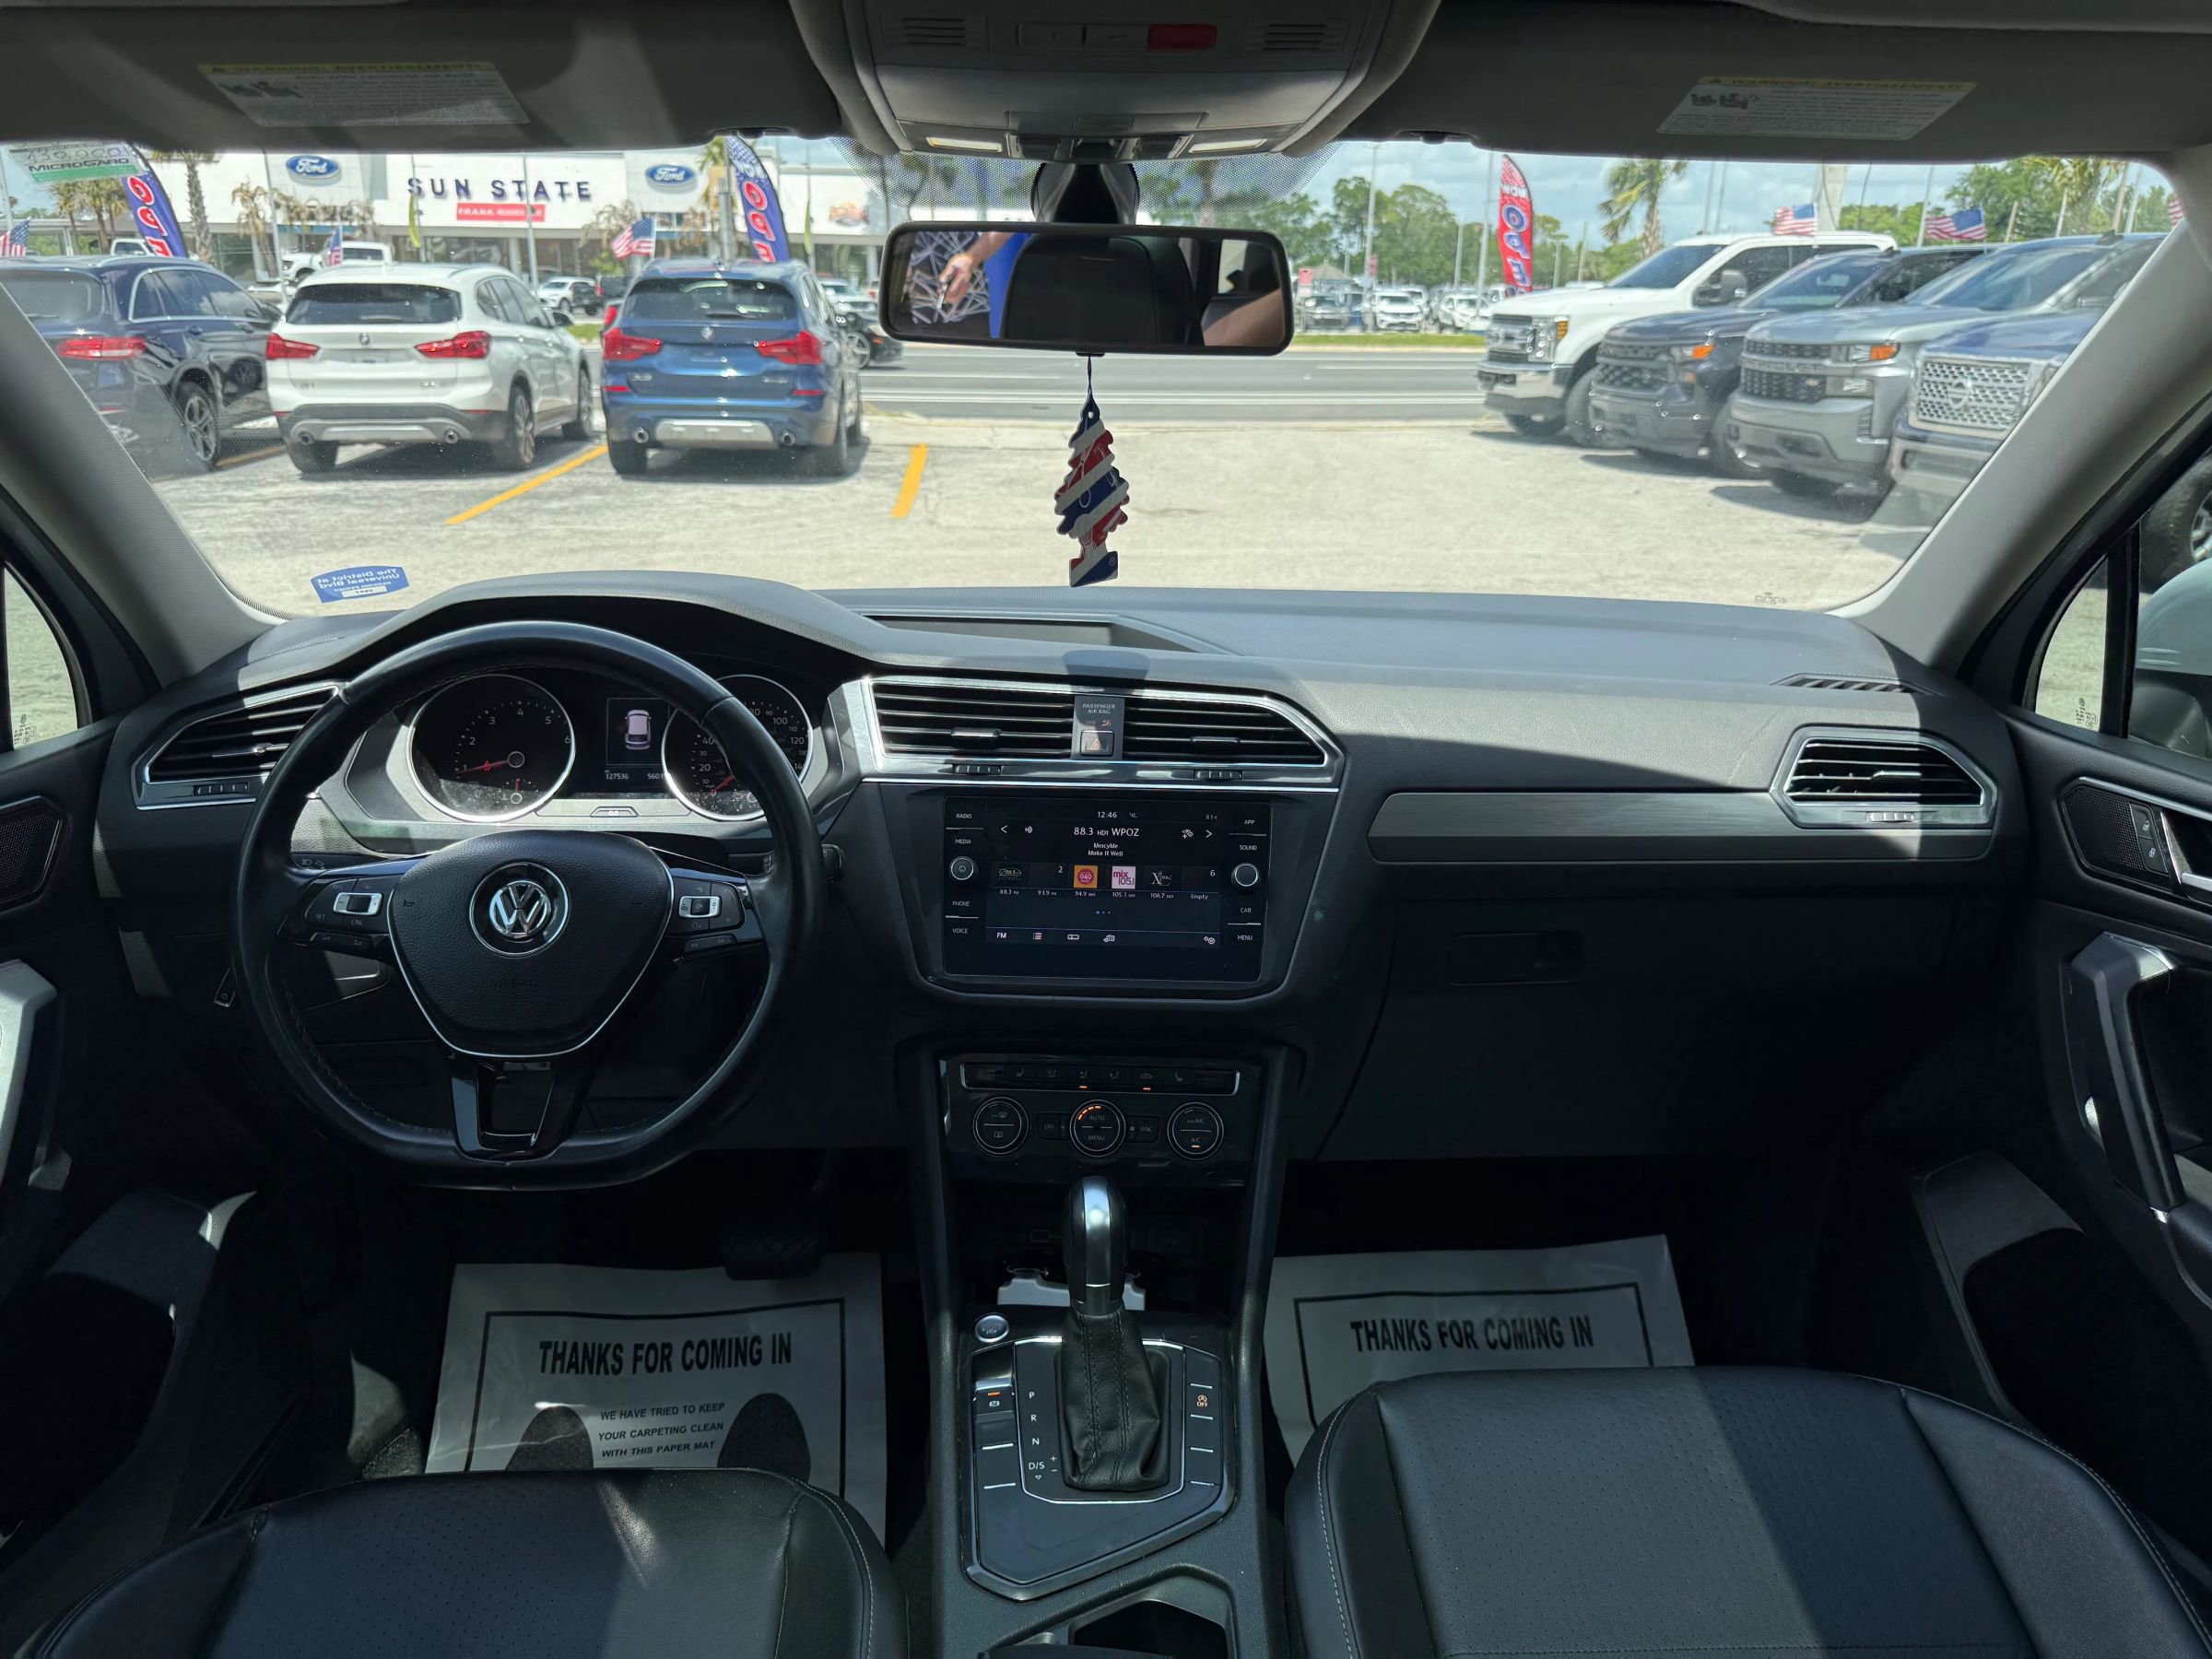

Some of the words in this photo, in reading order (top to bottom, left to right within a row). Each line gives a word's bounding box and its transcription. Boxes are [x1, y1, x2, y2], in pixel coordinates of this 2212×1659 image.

[295, 159, 327, 174] Ford
[653, 168, 686, 182] Ford
[407, 178, 470, 199] SUN
[490, 179, 592, 201] STATE
[488, 716, 496, 725] 3
[545, 716, 552, 724] 5
[773, 717, 787, 725] 100
[469, 736, 477, 746] 2
[790, 736, 805, 745] 120
[699, 763, 711, 772] 20
[606, 772, 629, 781] 127536
[1097, 811, 1117, 819] 12:46
[1074, 827, 1094, 837] 88.3
[1111, 828, 1140, 837] WPOZ
[1094, 842, 1119, 851] MercyMe
[1111, 850, 1124, 858] Well
[1058, 865, 1064, 874] 2
[1209, 869, 1216, 877] 6
[1191, 893, 1209, 901] Empty
[996, 931, 1007, 939] FM
[1349, 1319, 1433, 1353] THANKS
[1437, 1319, 1482, 1350] FOR
[1484, 1316, 1565, 1349] COMING
[1570, 1314, 1594, 1347] IN
[538, 1339, 624, 1377] THANKS
[631, 1342, 673, 1373] FOR
[680, 1335, 764, 1371] COMING
[771, 1332, 793, 1365] IN
[1029, 1391, 1035, 1399] P
[600, 1410, 617, 1421] WE
[619, 1407, 647, 1419] HAVE
[650, 1405, 680, 1418] TRIED
[683, 1404, 696, 1415] TO
[698, 1401, 726, 1414] KEEP
[1030, 1414, 1037, 1422] R
[598, 1430, 627, 1441] YOUR
[629, 1425, 688, 1438] CARPETING
[690, 1422, 724, 1433] CLEAN
[601, 1447, 629, 1458] WITH
[630, 1444, 653, 1456] THIS
[656, 1442, 691, 1454] PAPER
[694, 1440, 716, 1452] MAT
[1028, 1461, 1045, 1471] D/S
